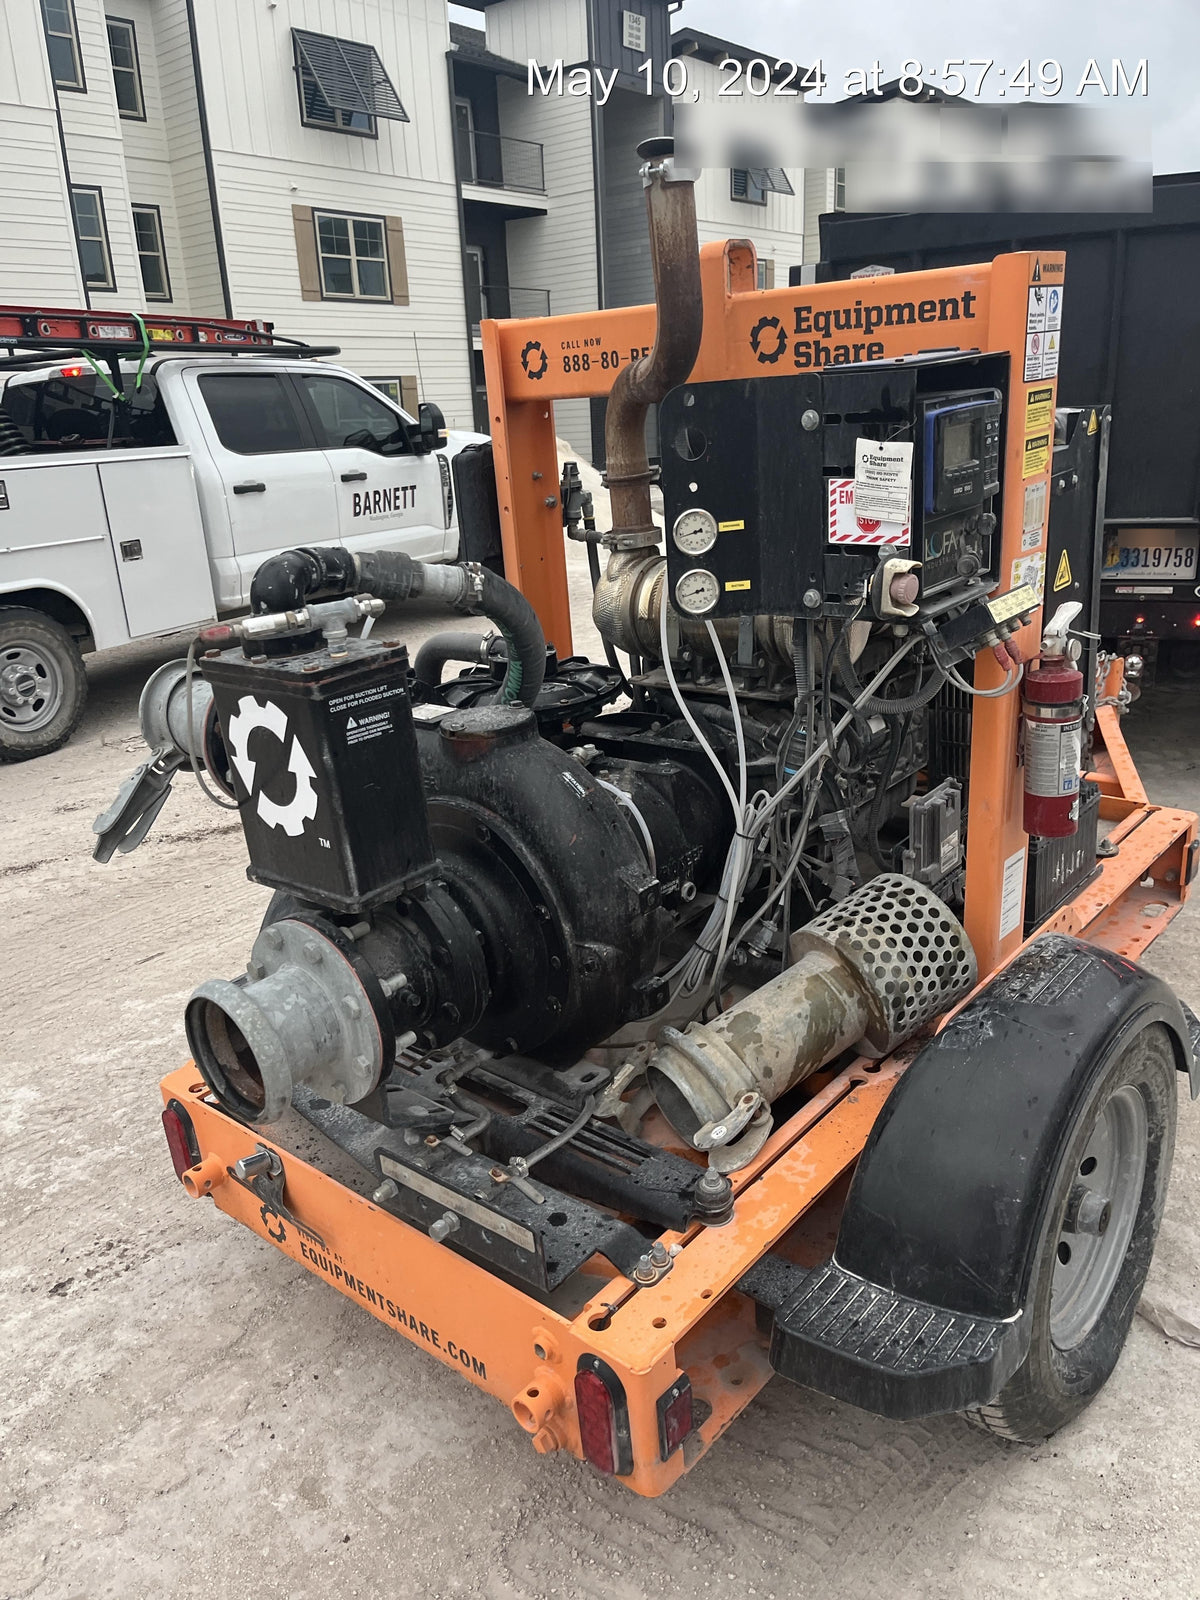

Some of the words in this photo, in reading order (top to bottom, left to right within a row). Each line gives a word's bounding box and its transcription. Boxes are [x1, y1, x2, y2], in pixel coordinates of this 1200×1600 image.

[1042, 263, 1064, 273] WARNING
[793, 290, 976, 338] Equipment
[560, 341, 580, 350] CALL
[583, 337, 601, 348] NOW
[562, 346, 654, 373] 888-80-RE
[793, 340, 885, 368] Share
[1034, 392, 1051, 401] WARNING
[1031, 438, 1048, 448] WARNING
[869, 454, 904, 463] Equipment
[869, 460, 887, 468] Share
[353, 485, 417, 517] BARNETT
[924, 529, 958, 561] LOFA
[1120, 547, 1194, 568] 3319758
[328, 697, 343, 706] OPEN
[343, 694, 354, 702] FOR
[355, 688, 377, 699] SUCTION
[377, 684, 388, 693] LIFT
[329, 705, 347, 713] CLOSE
[358, 694, 382, 704] FLOODED
[382, 687, 404, 698] SUCTION
[358, 711, 390, 726] WARNING!
[318, 837, 331, 849] TM
[333, 1251, 346, 1265] AT:
[300, 1241, 487, 1381] EQUIPMENTSHARE.COM
